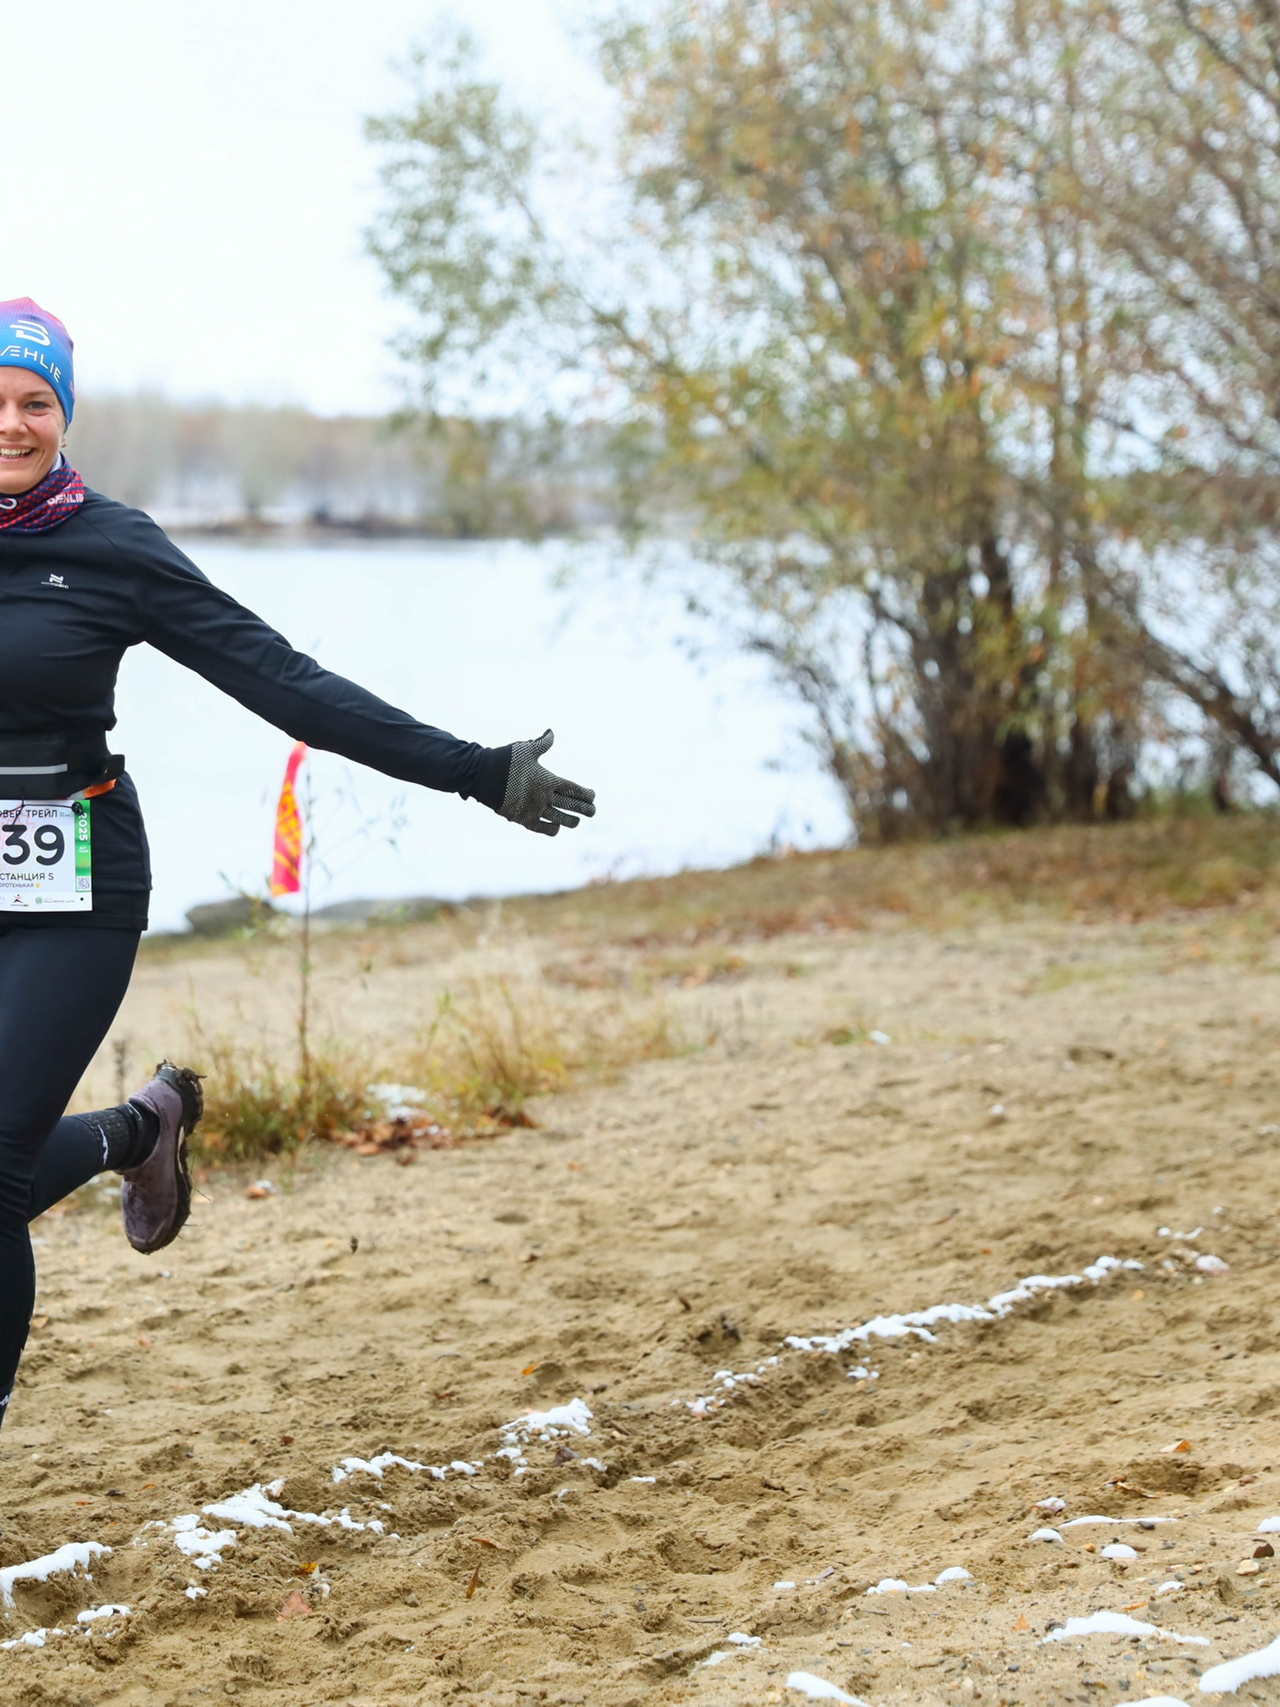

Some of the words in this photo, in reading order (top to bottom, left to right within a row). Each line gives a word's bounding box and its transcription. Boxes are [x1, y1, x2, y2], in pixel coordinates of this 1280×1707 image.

[26, 809, 57, 818] ТРЕЙЛ
[78, 812, 88, 841] 2025
[48, 872, 54, 881] S
